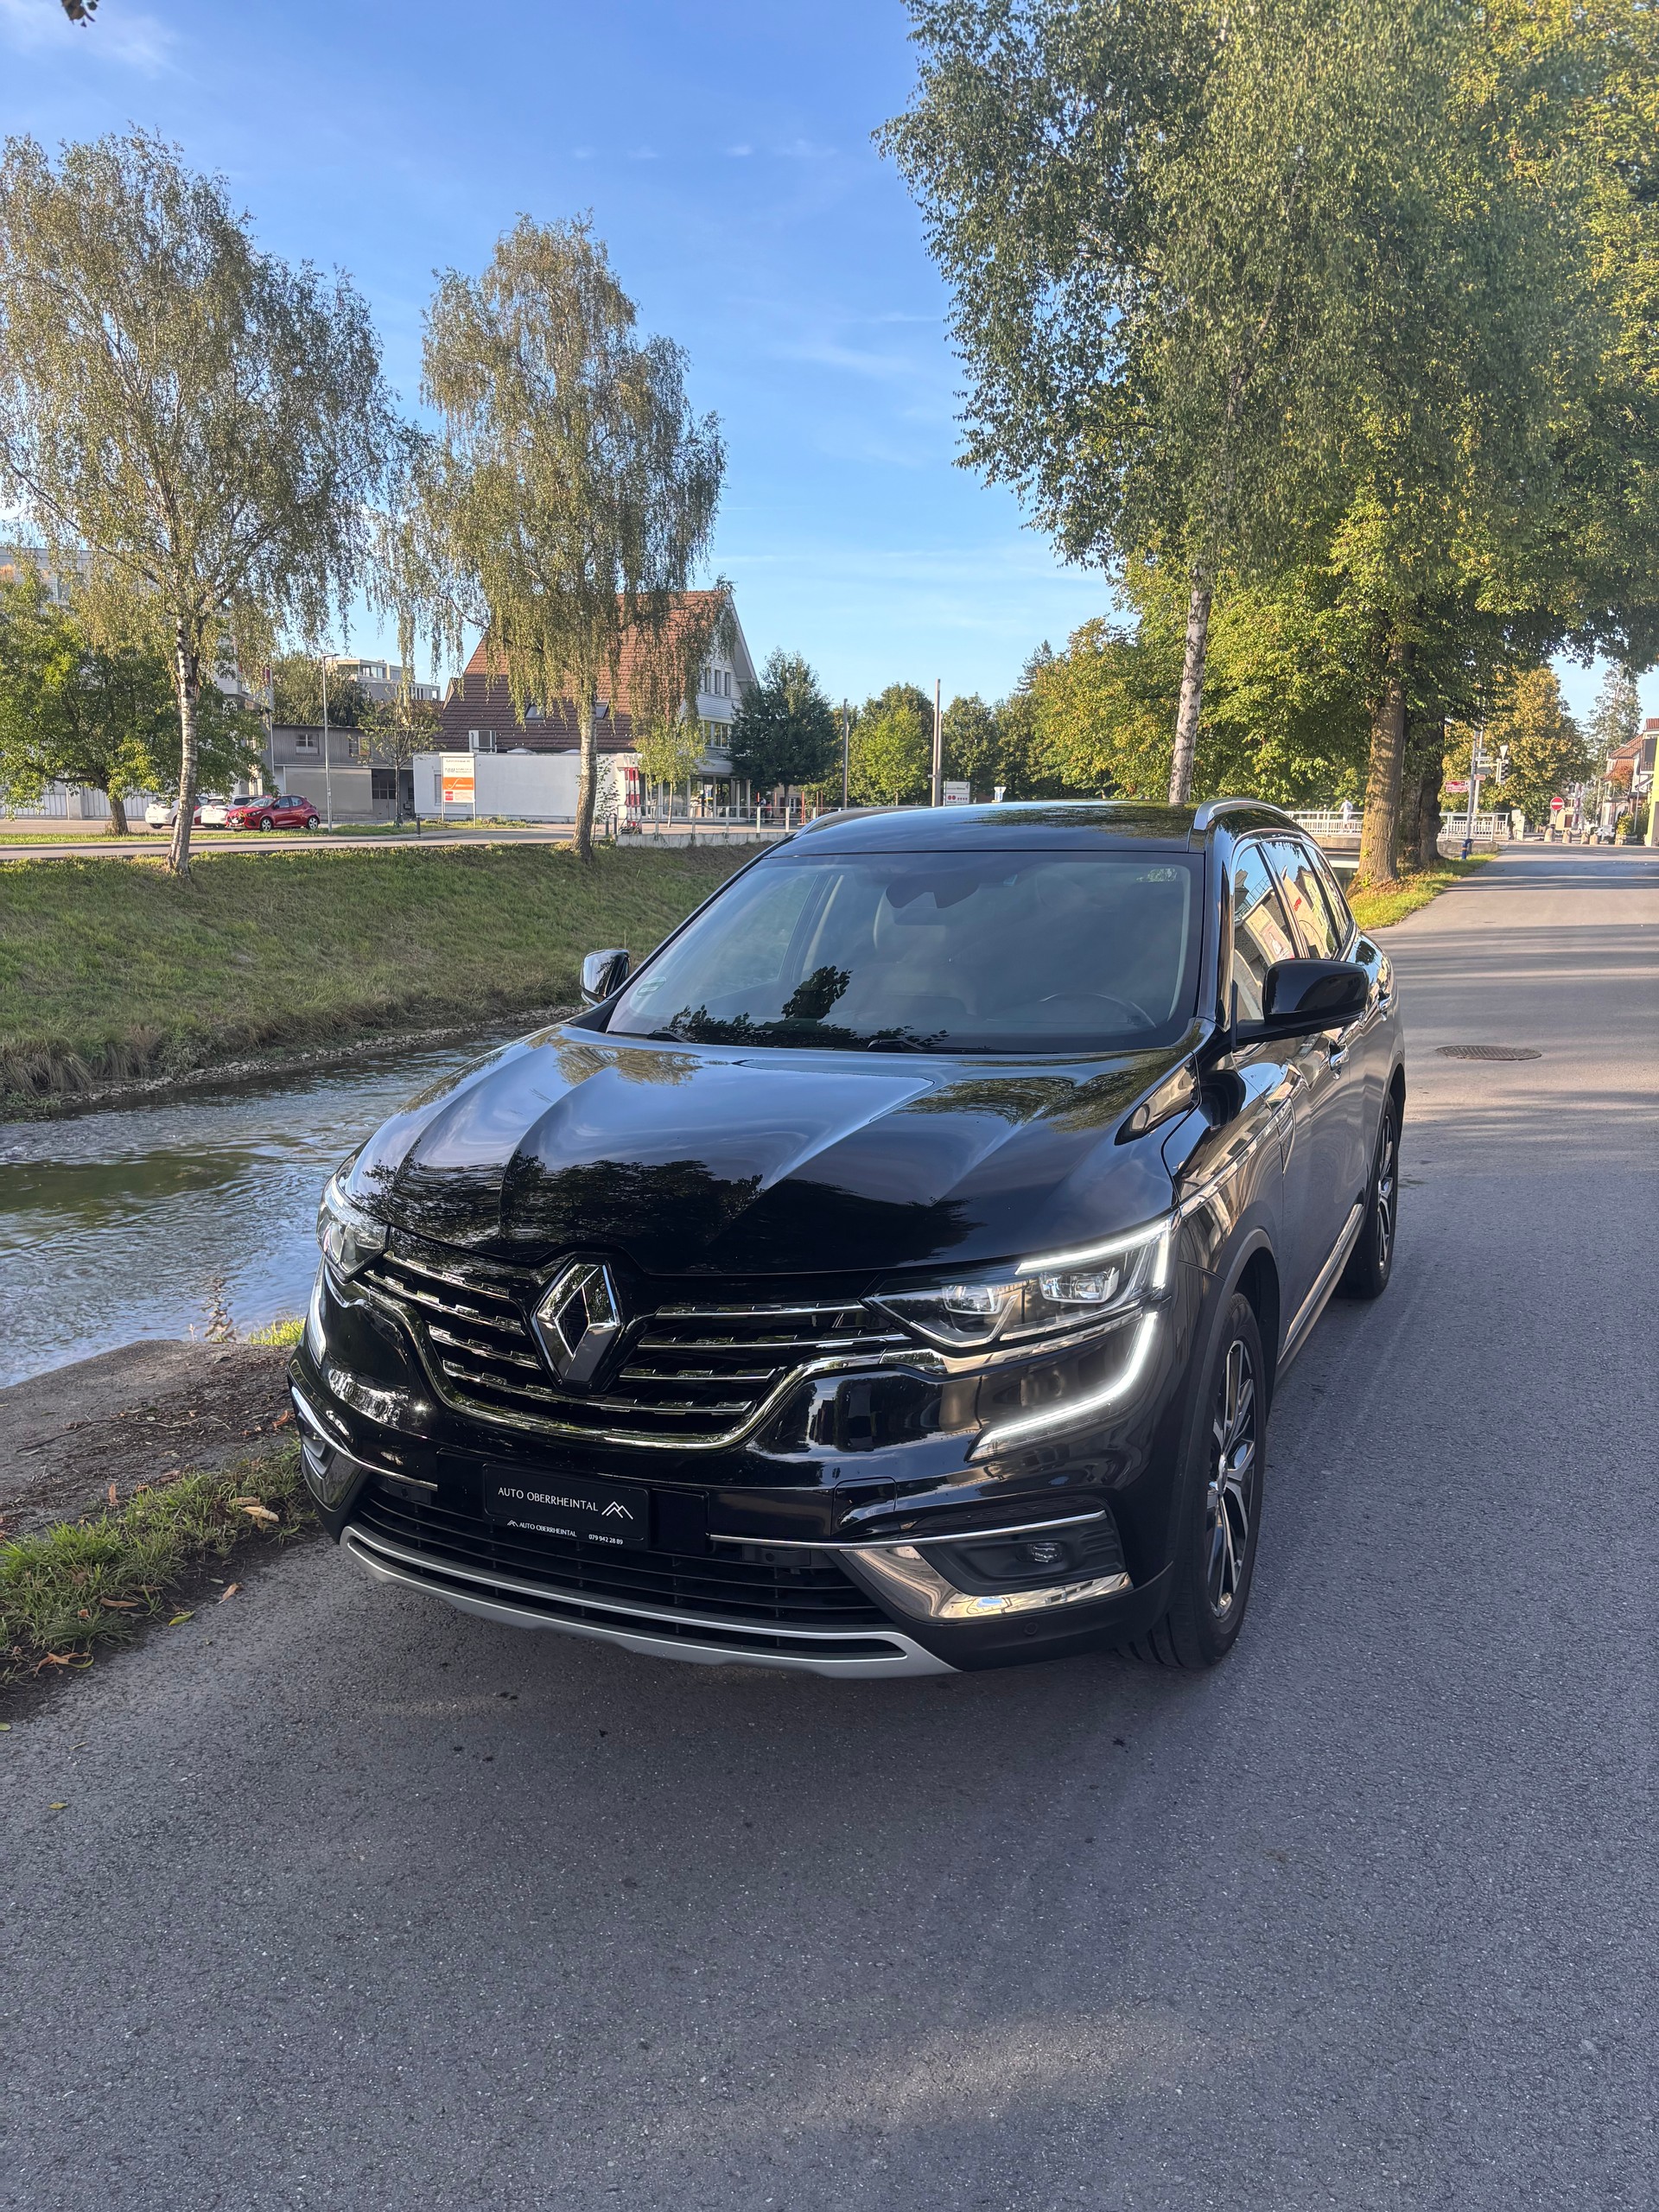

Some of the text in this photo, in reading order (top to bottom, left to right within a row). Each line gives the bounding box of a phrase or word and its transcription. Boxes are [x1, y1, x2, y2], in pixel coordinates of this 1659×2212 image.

[498, 1487, 599, 1512] AUTO OBERRHEINTAL
[519, 1522, 536, 1530] AUTO
[536, 1524, 577, 1537] OBERRHEINTAL
